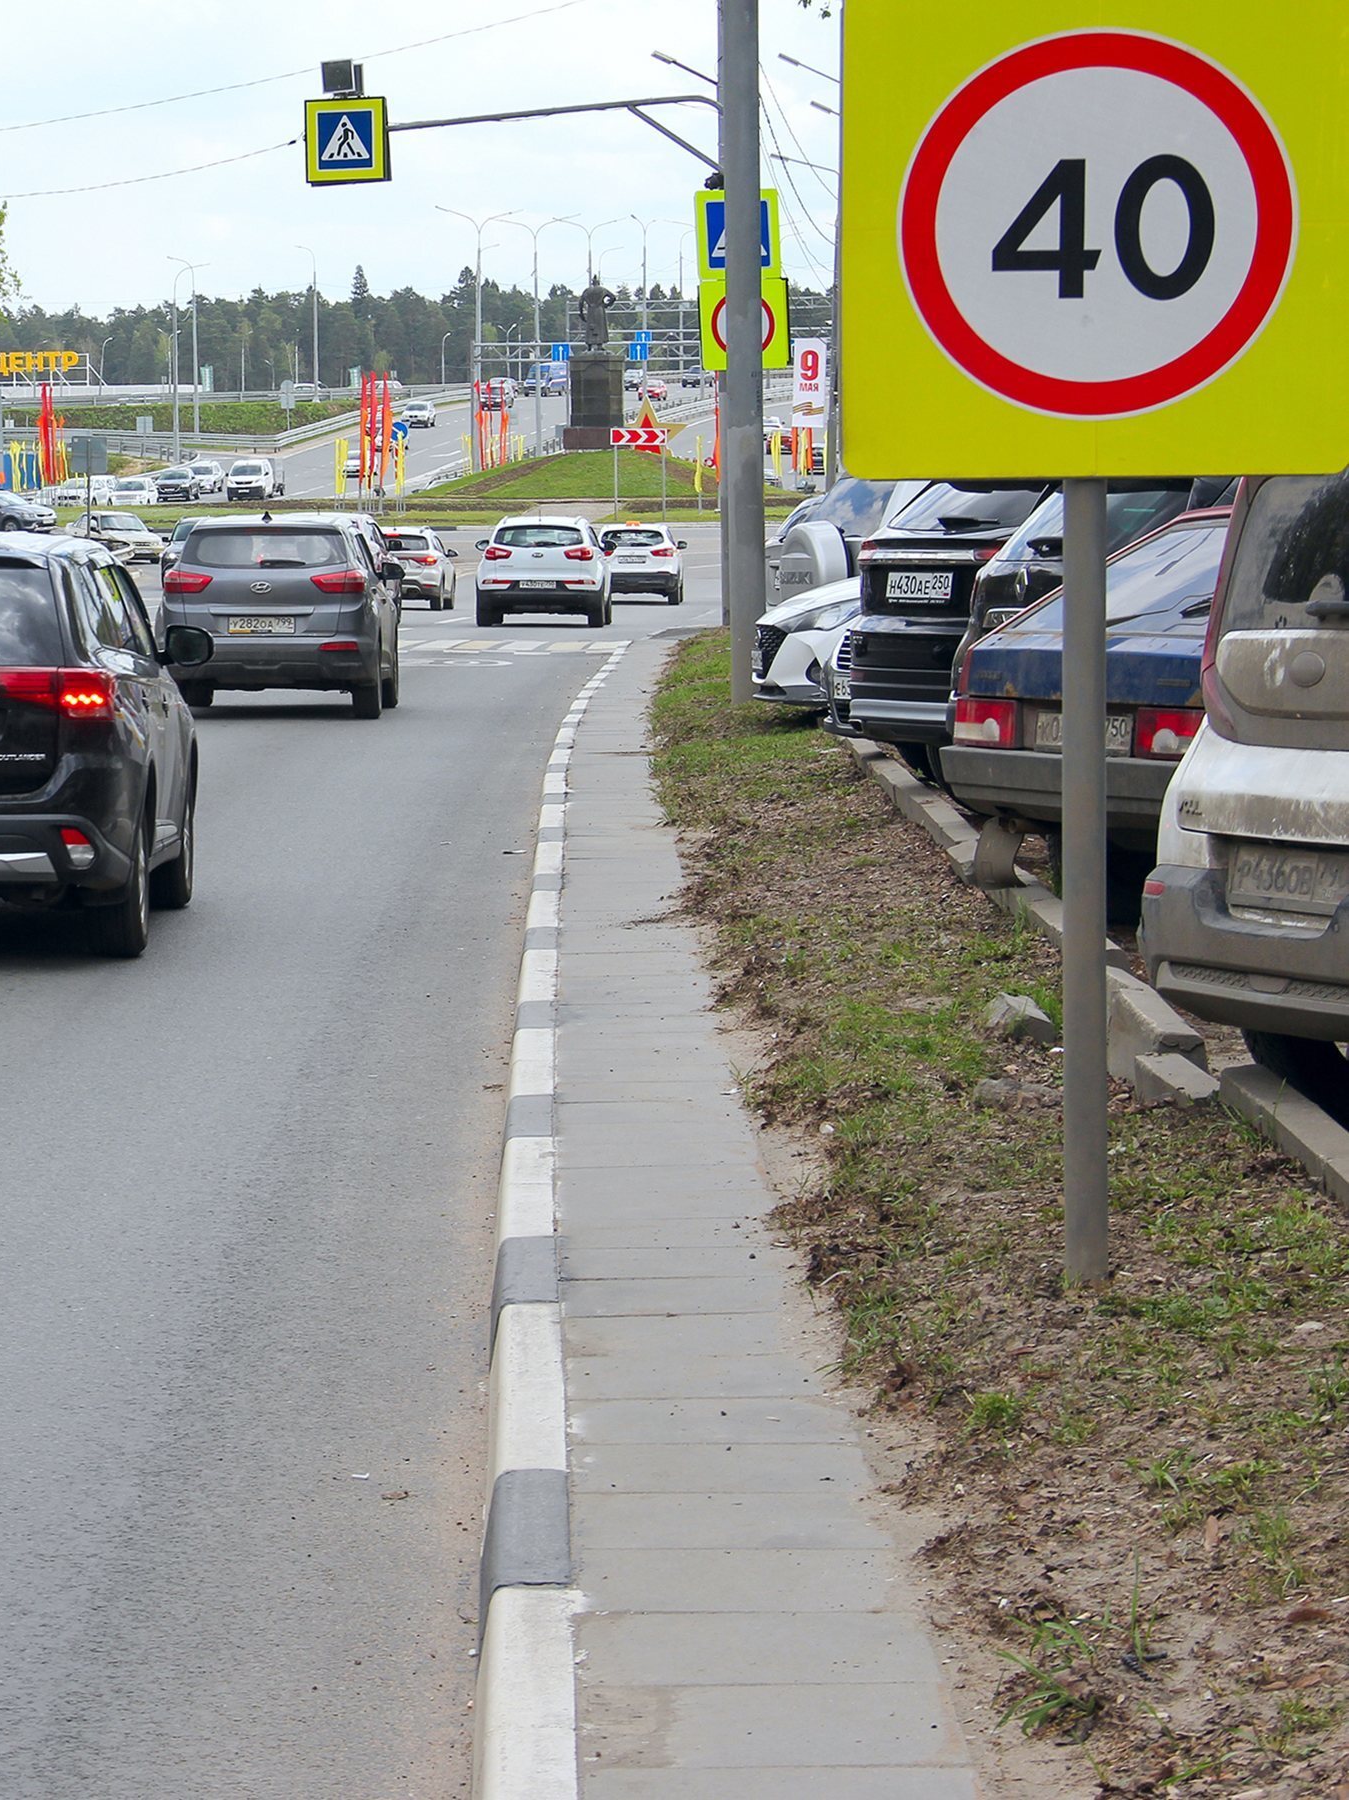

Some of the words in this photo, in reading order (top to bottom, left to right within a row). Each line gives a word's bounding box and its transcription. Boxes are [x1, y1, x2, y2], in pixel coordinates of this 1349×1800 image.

[991, 153, 1216, 301] 40
[800, 350, 819, 381] 9
[799, 383, 819, 392] МАЯ
[889, 575, 931, 595] Н430АЕ
[932, 575, 950, 590] 250
